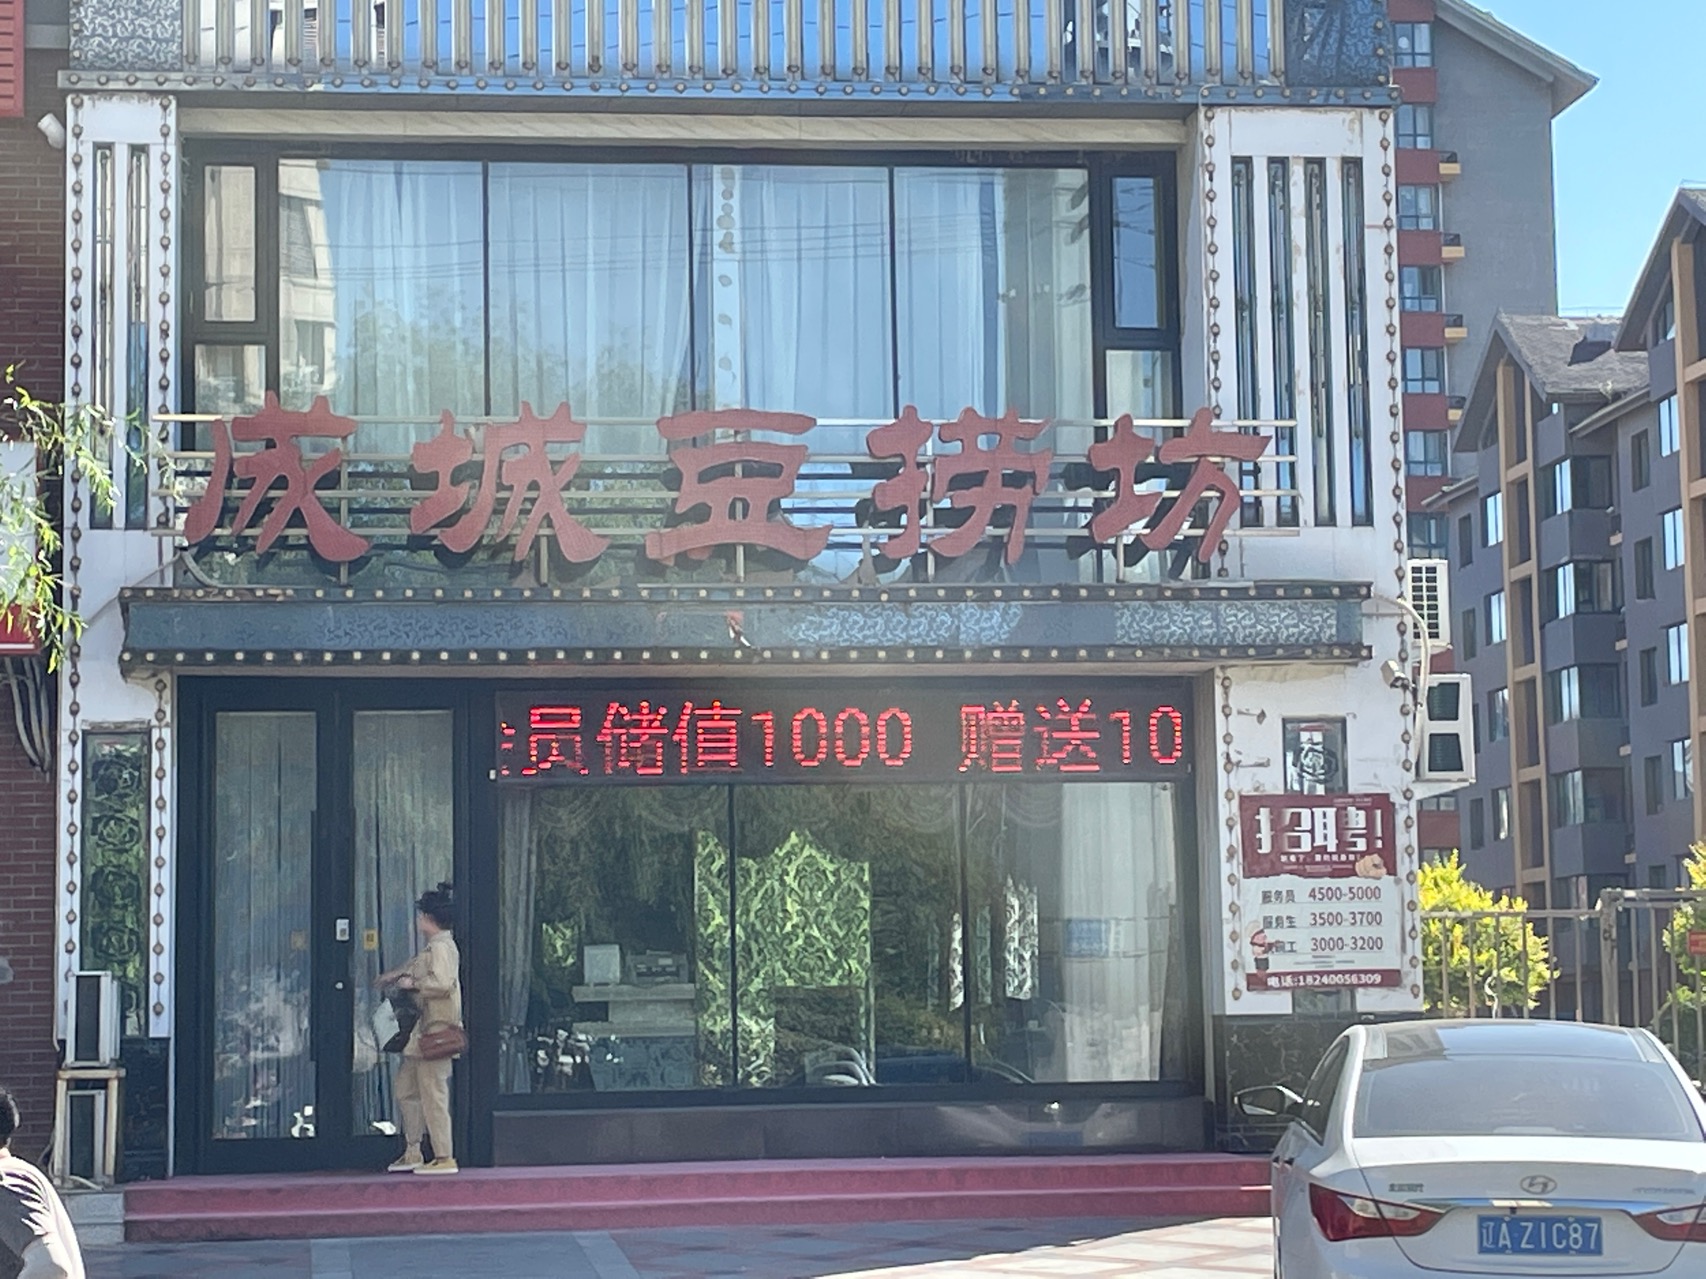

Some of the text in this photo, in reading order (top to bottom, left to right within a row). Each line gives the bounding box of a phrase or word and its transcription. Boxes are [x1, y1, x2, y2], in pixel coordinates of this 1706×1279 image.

[1308, 886, 1382, 901] 4500-5000
[1309, 911, 1383, 926] 3500-3700
[1311, 936, 1384, 952] 3000-3200
